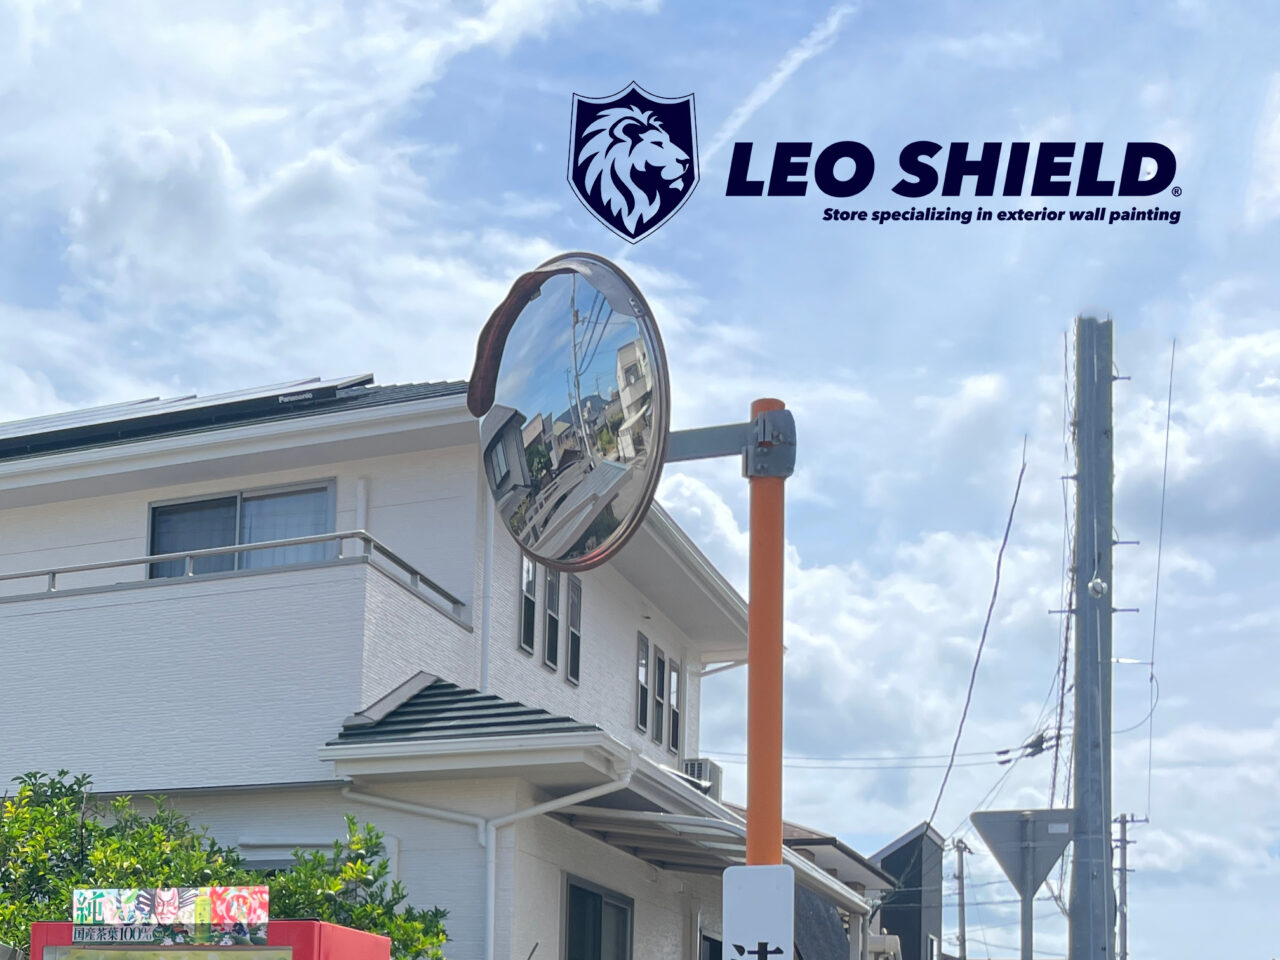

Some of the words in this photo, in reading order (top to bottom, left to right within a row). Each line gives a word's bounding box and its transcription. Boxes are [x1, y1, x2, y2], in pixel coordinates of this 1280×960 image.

[278, 392, 313, 404] Panasonic
[76, 891, 105, 924] 純
[73, 926, 153, 942] 国産茶葉100%
